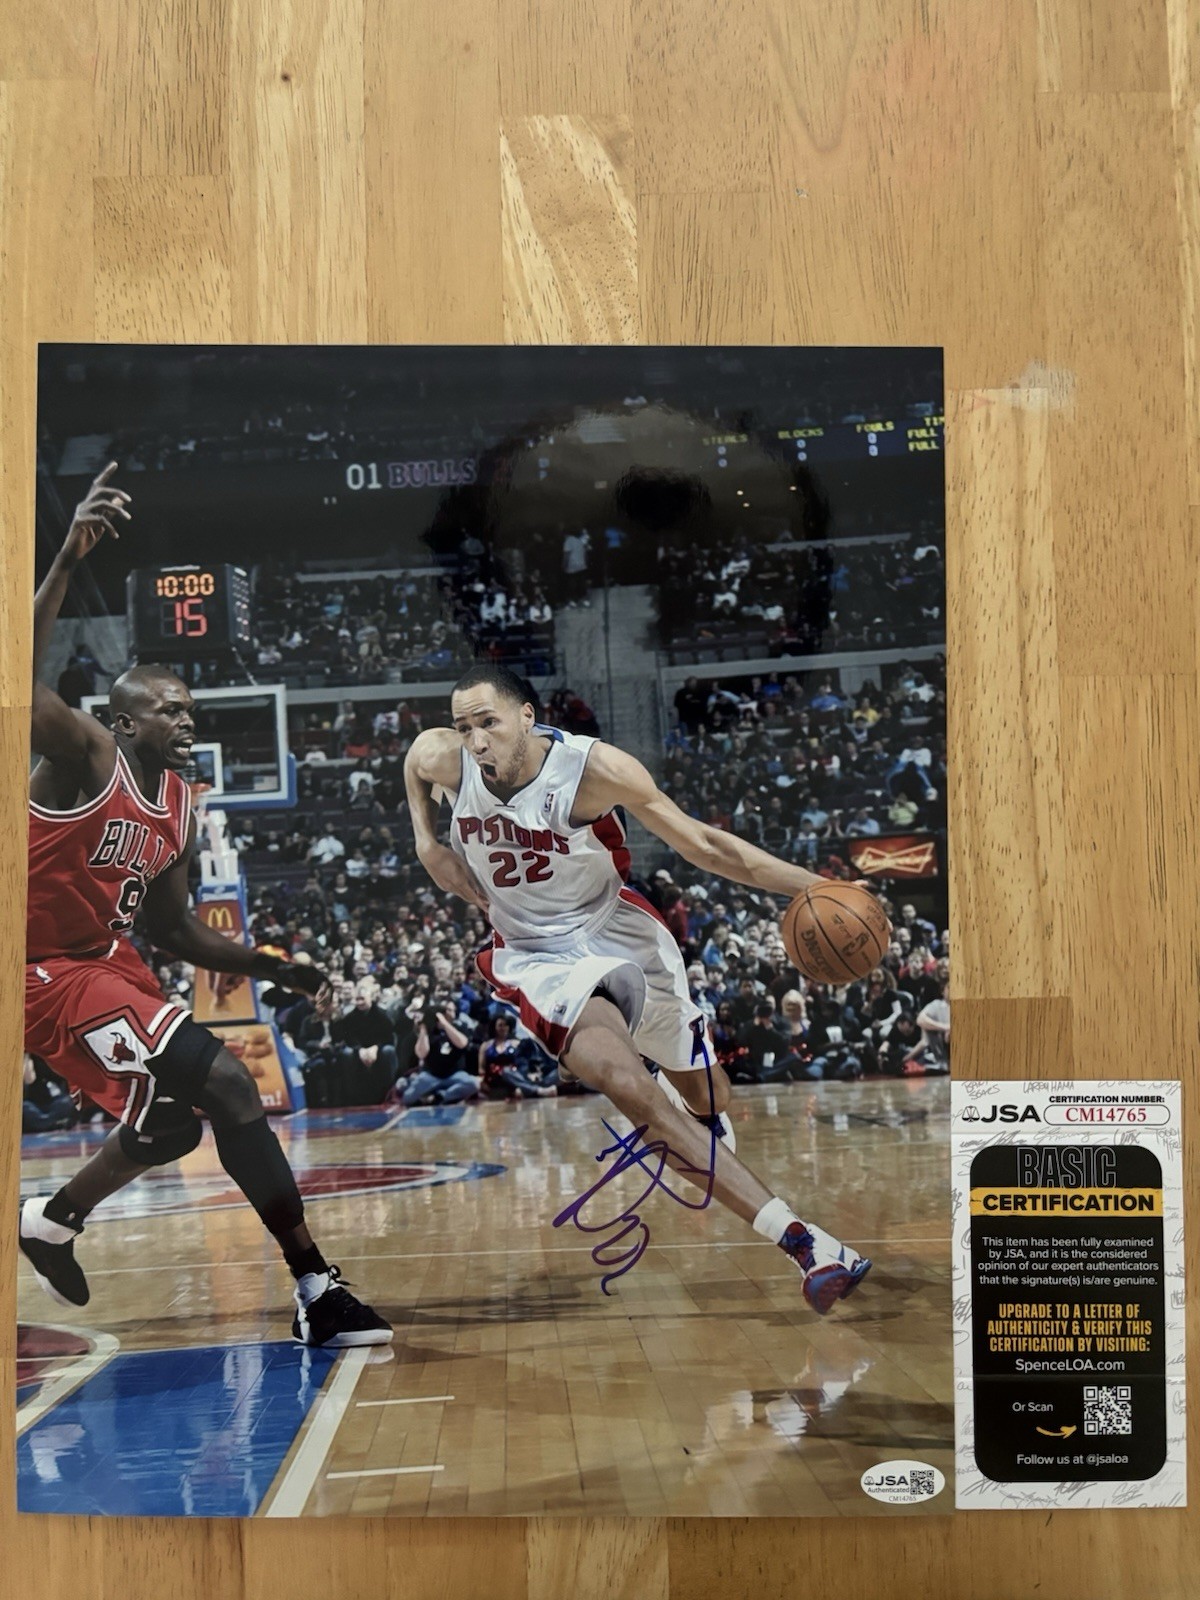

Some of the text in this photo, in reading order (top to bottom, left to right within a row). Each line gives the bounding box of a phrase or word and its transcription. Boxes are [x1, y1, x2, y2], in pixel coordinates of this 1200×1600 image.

[778, 428, 824, 439] BLOCKS
[856, 421, 895, 433] FOULS
[907, 428, 938, 440] FULL
[908, 440, 939, 452] FULL
[387, 458, 478, 489] BULLS
[156, 573, 215, 598] 10:00
[174, 598, 208, 637] 15
[457, 813, 570, 855] PISTONS
[488, 850, 554, 888] 22
[108, 877, 147, 932] 9
[1049, 1095, 1165, 1103] CERTIFICATION NUMBER:
[980, 1104, 1042, 1123] JSA
[1065, 1107, 1147, 1123] CM14765
[1018, 1147, 1116, 1188] BASIC
[982, 1194, 1154, 1212] CERTIFICATION
[982, 1236, 1154, 1249] This item has been fully examined
[988, 1248, 1148, 1261] by JSA, and it is the considered
[977, 1261, 1017, 1273] opinion
[1018, 1260, 1029, 1271] of
[1031, 1262, 1050, 1271] our
[1051, 1261, 1084, 1273] expert
[1086, 1260, 1159, 1272] authenticators
[979, 1274, 1158, 1287] that the signature(s) is/are genuine.
[998, 1303, 1140, 1319] UPGRADE TO A LETTER OF
[987, 1319, 1153, 1336] AUTHENTICITY & VERIFY THIS
[989, 1336, 1151, 1352] CERTIFICATION BY VISITING:
[1015, 1358, 1126, 1374] SpenceLOA.com
[1011, 1401, 1054, 1412] Or Scan
[1016, 1453, 1129, 1467] Follow us at @jsaloa
[875, 1475, 909, 1486] JSA
